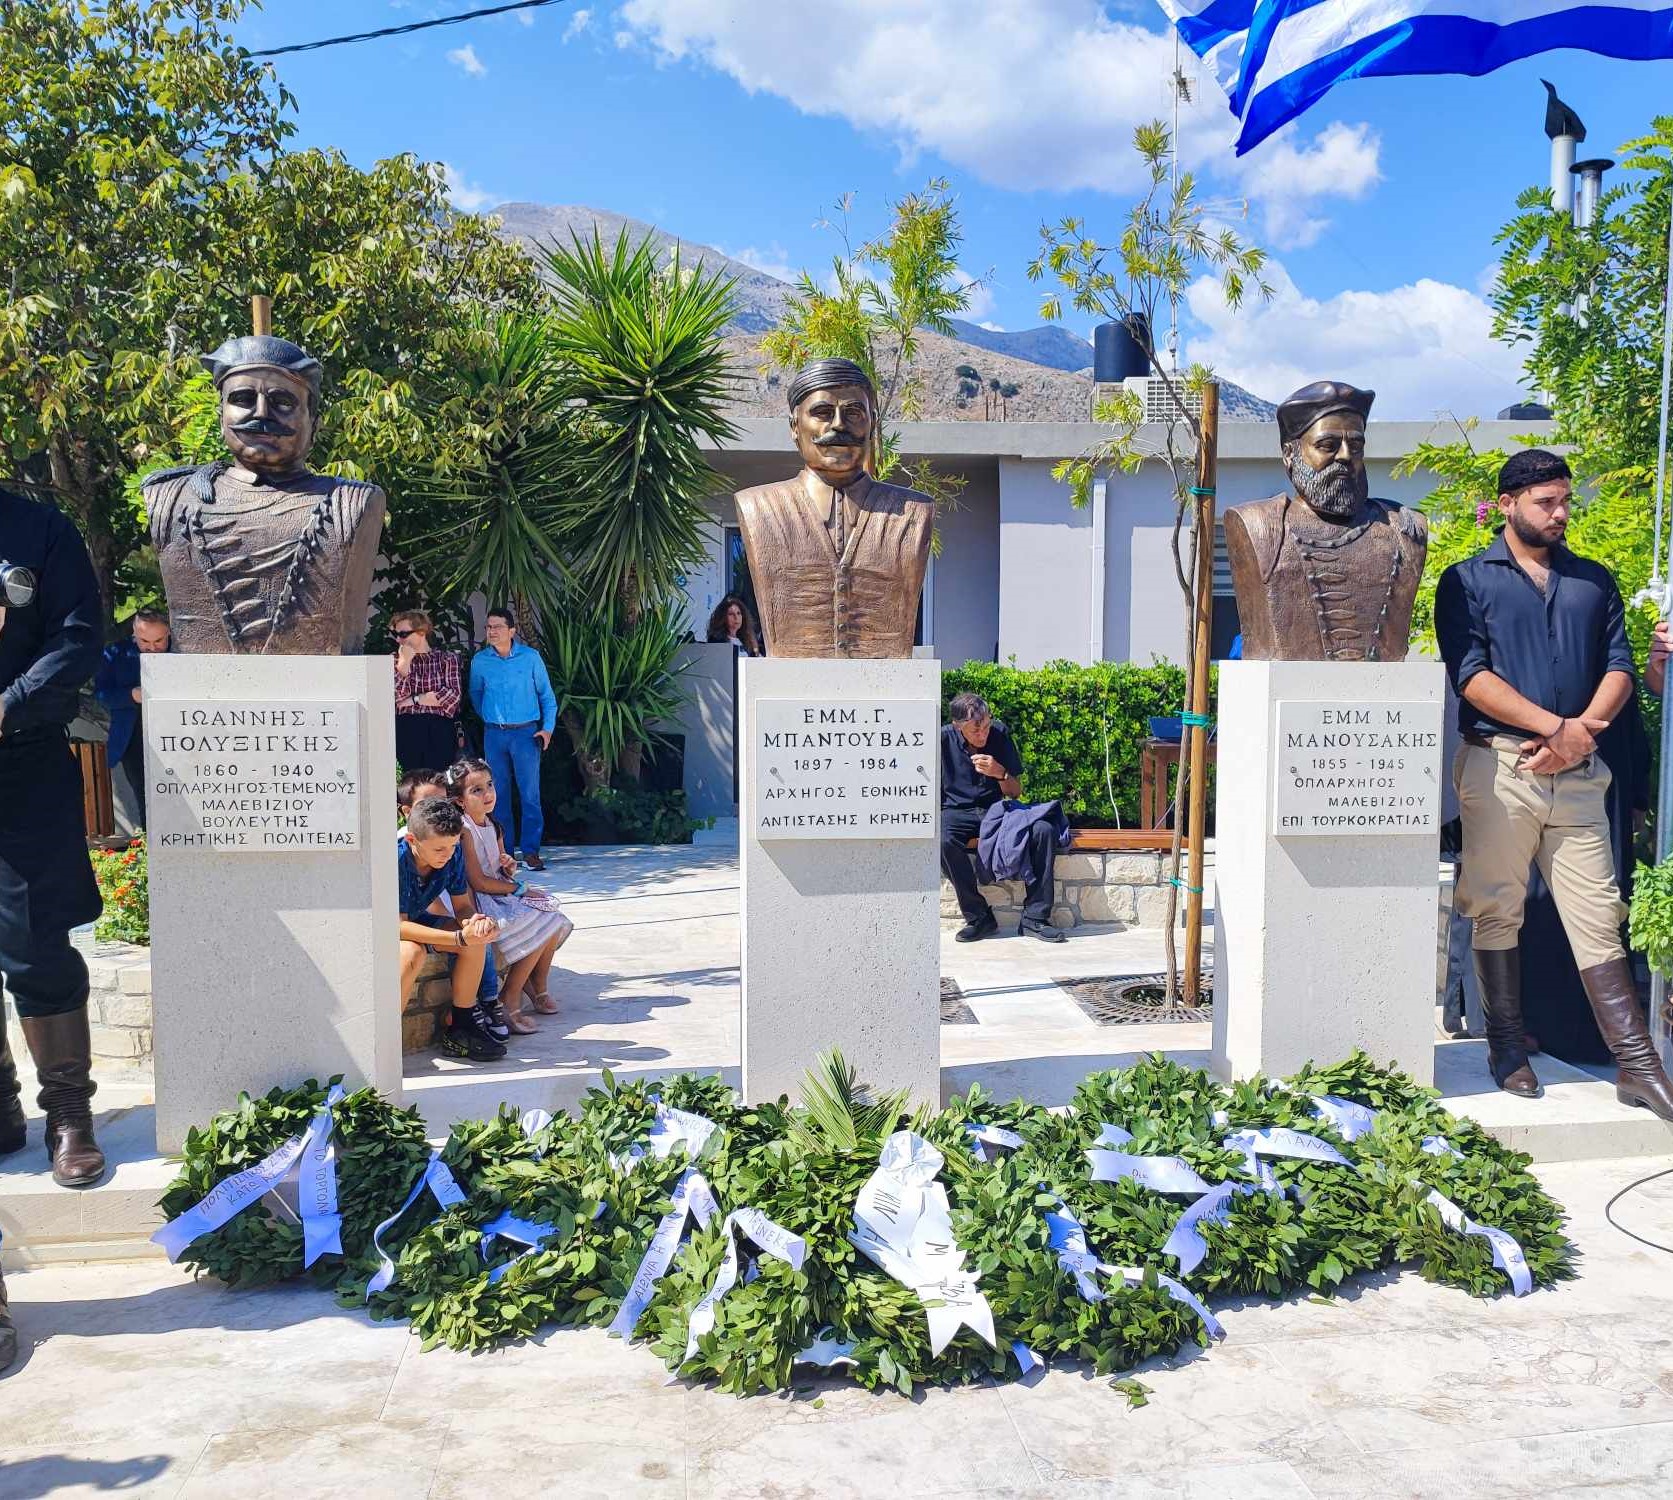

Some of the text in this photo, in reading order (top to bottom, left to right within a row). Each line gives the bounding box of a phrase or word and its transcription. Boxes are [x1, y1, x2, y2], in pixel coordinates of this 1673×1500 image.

[160, 736, 339, 752] ΠΟΛΥΞΙΓΚΗΣ
[763, 732, 924, 747] ΜΠΑΝΤΟΥΒΑΣ
[1288, 733, 1437, 748] ΜΑΝΟΥΣΑΚΗΣ
[194, 764, 238, 777] 1860
[272, 764, 315, 777] 1940
[793, 759, 832, 770] 1897
[860, 758, 898, 770] 1984
[1312, 759, 1347, 770] 1855
[1370, 759, 1405, 769] 1945
[1294, 778, 1396, 788] ΟΠΛΑΡΧΗΓΟΣ
[765, 785, 928, 799] ΑΡΧΗΓΟΣ ΕΘΝΙΚΗΣ
[202, 799, 314, 811] ΜΑΛΕΒΙΖΙΟΥ
[1329, 797, 1426, 807] ΜΑΛΕΒΙΖΙΟΥ
[202, 815, 309, 828] ΒΟΥΛΕΥΤΗΣ
[761, 813, 931, 826] ΑΝΤΙΣΤΑΣΗΣ ΚΡΗΤΗΣ
[1282, 815, 1430, 827] ΕΠΙ ΤΟΥΡΚΟΚΡΑΤΙΑΣ
[161, 832, 356, 846] ΚΡΗΤΙΚΗΣ ΠΟΛΙΤΕΙΑΣ
